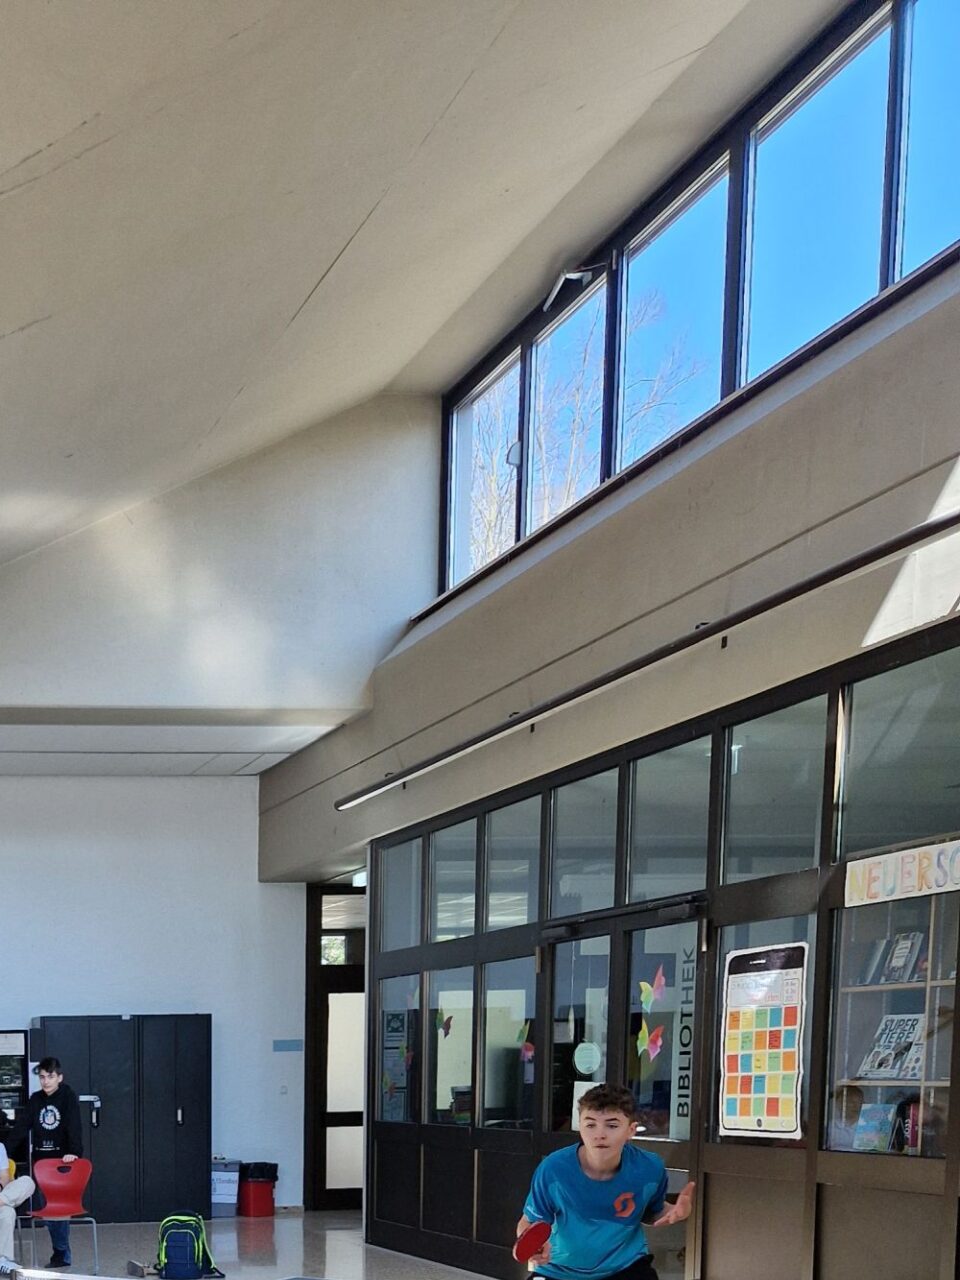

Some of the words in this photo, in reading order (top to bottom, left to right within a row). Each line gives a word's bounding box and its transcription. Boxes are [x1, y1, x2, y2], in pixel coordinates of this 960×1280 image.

[676, 945, 695, 1118] BIBLIOTHEK
[883, 1018, 919, 1032] SUPER
[879, 1030, 915, 1044] TIERE
